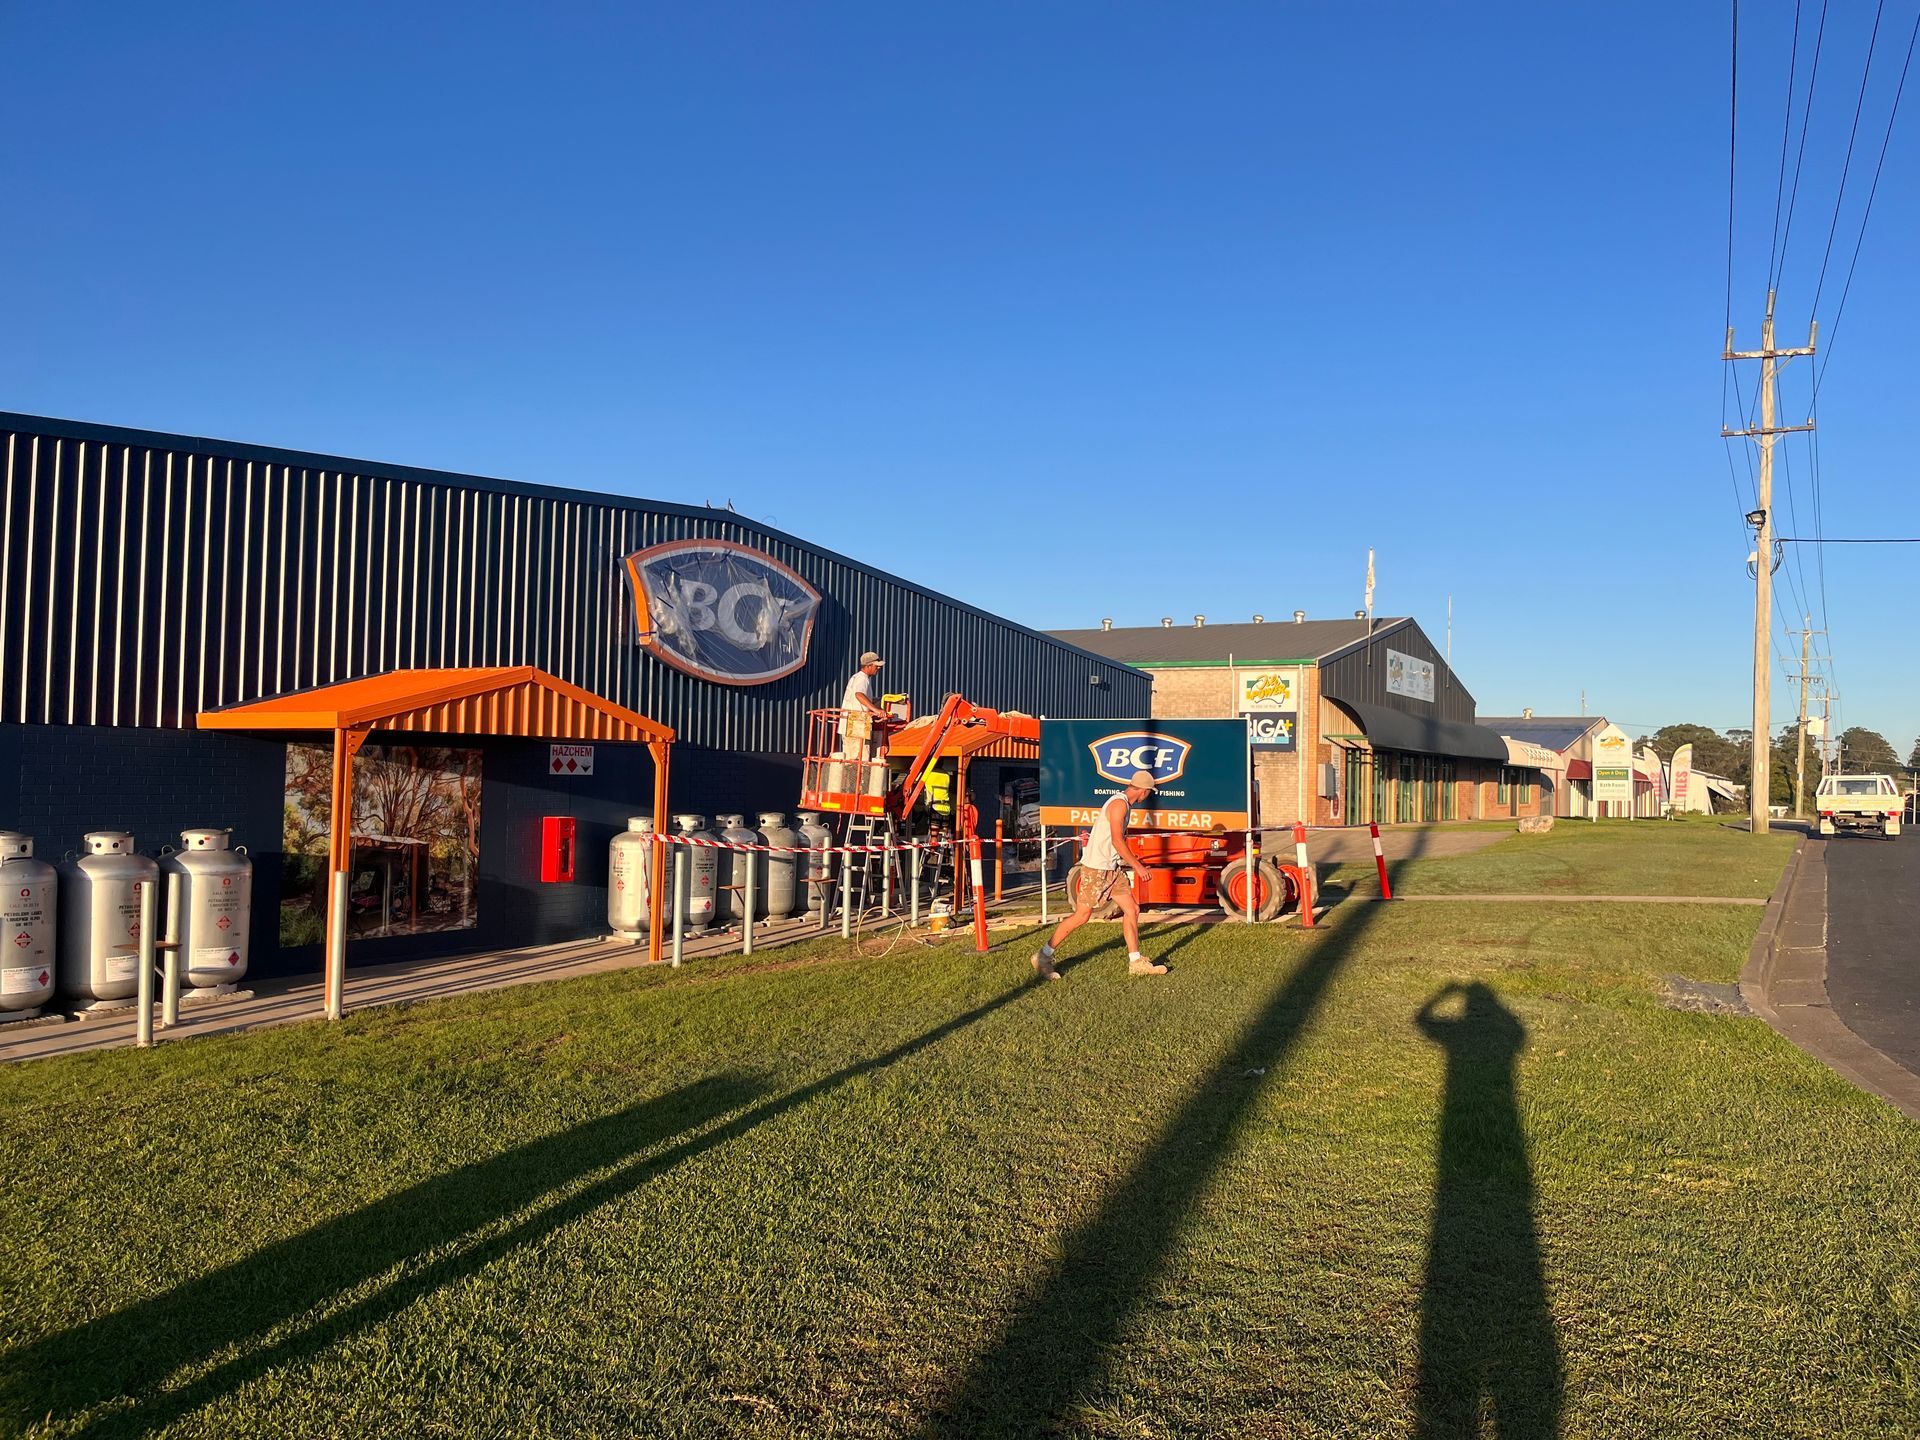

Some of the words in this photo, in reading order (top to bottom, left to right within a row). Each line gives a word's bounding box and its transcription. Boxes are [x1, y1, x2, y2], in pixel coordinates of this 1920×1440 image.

[552, 746, 592, 757] HAZCHEM
[1106, 745, 1174, 770] BCF
[1675, 771, 1688, 798] TILES
[1070, 810, 1139, 825] PARG
[1142, 812, 1163, 826] AT
[1167, 813, 1212, 828] REAR
